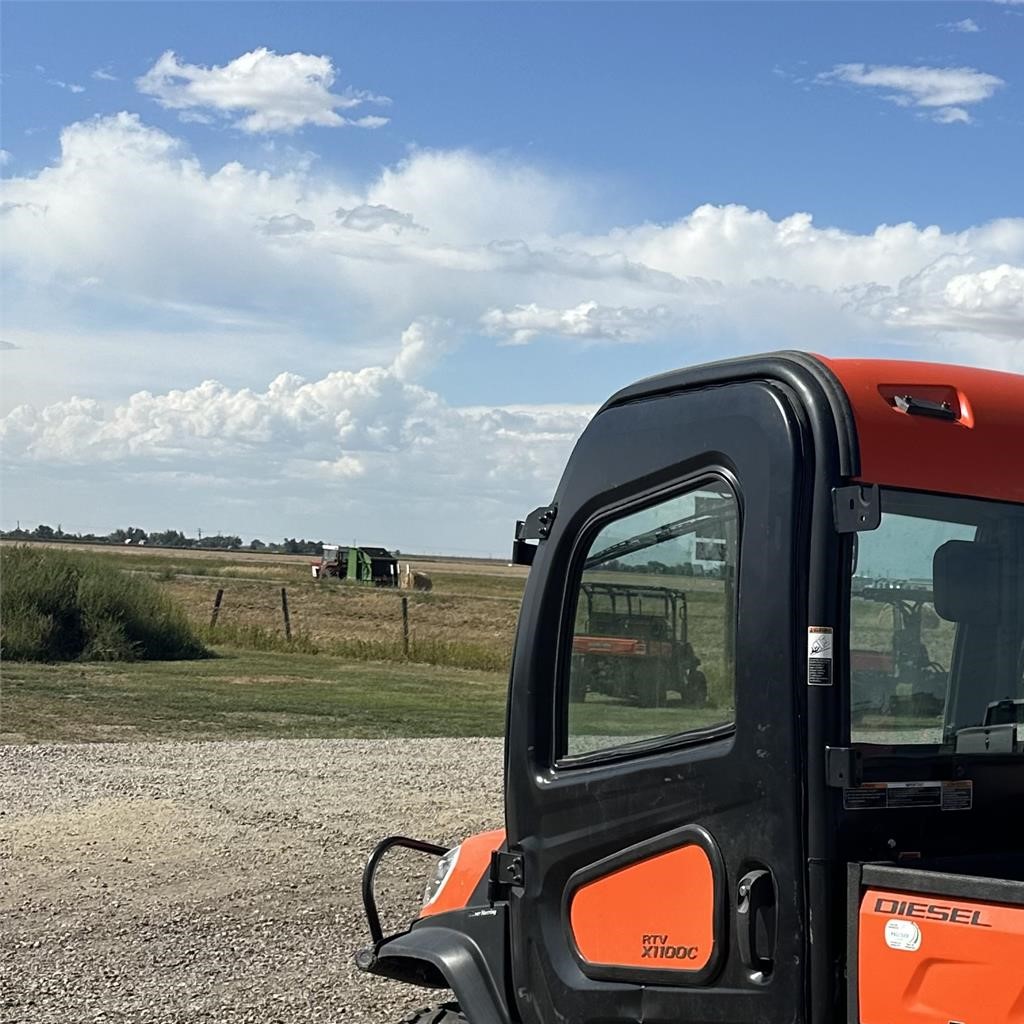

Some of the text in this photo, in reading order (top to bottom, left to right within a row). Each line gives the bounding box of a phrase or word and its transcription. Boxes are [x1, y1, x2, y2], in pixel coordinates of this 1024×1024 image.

[874, 898, 992, 927] DIESEL
[642, 934, 668, 945] RTV
[641, 945, 699, 960] X1100C
